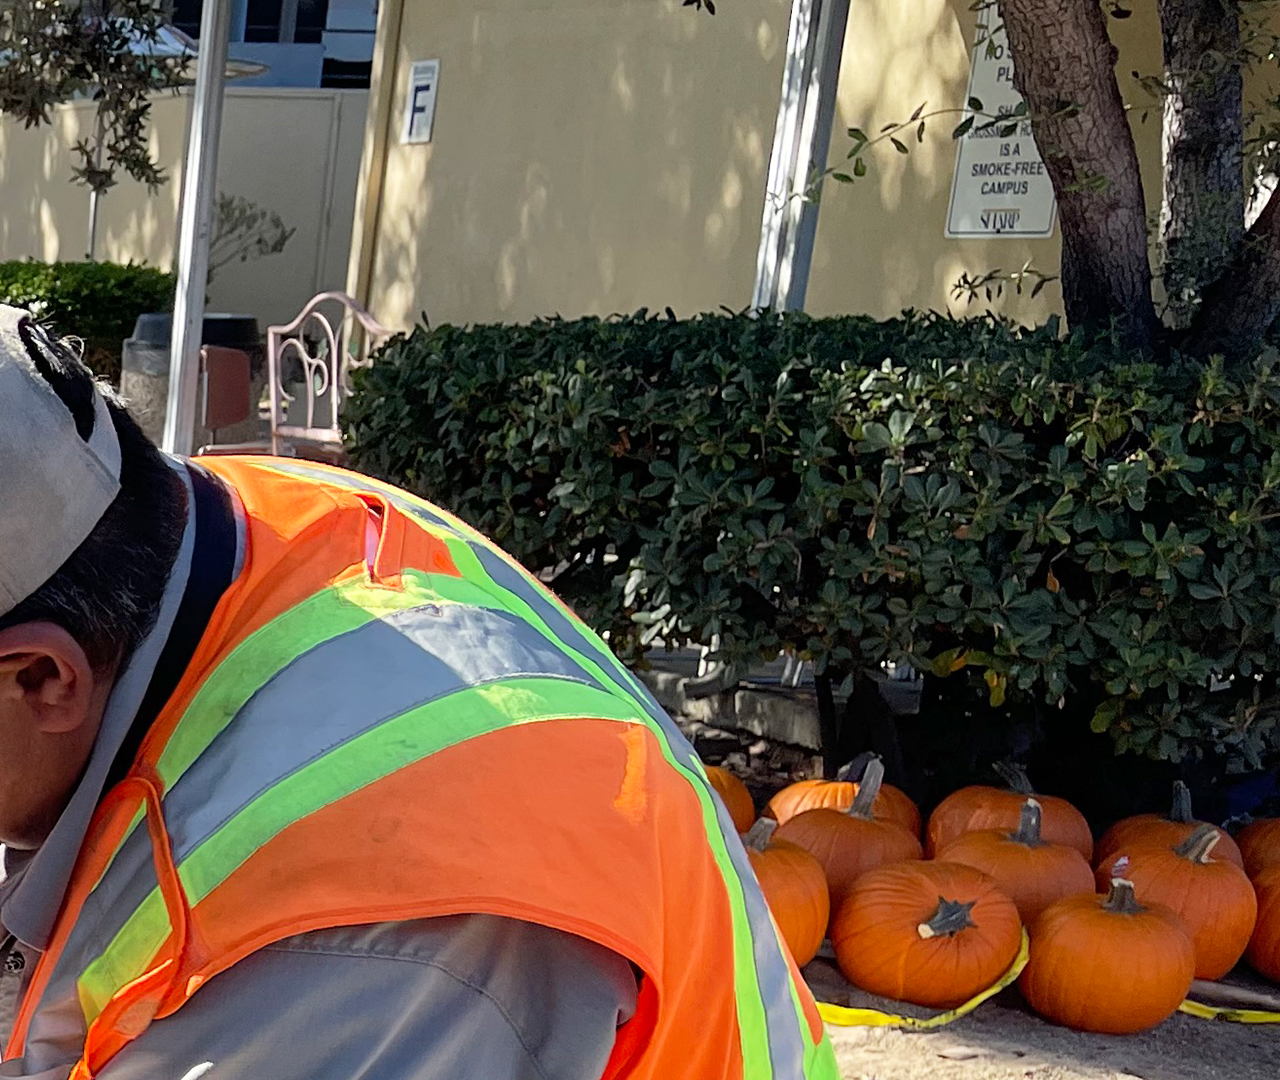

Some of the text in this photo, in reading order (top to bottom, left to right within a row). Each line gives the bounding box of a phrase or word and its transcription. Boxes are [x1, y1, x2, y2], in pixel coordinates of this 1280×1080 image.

[408, 84, 431, 137] F
[1000, 142, 1021, 157] IS A
[971, 161, 1044, 177] SMOKE-FREE
[981, 181, 1029, 195] CAMPUS
